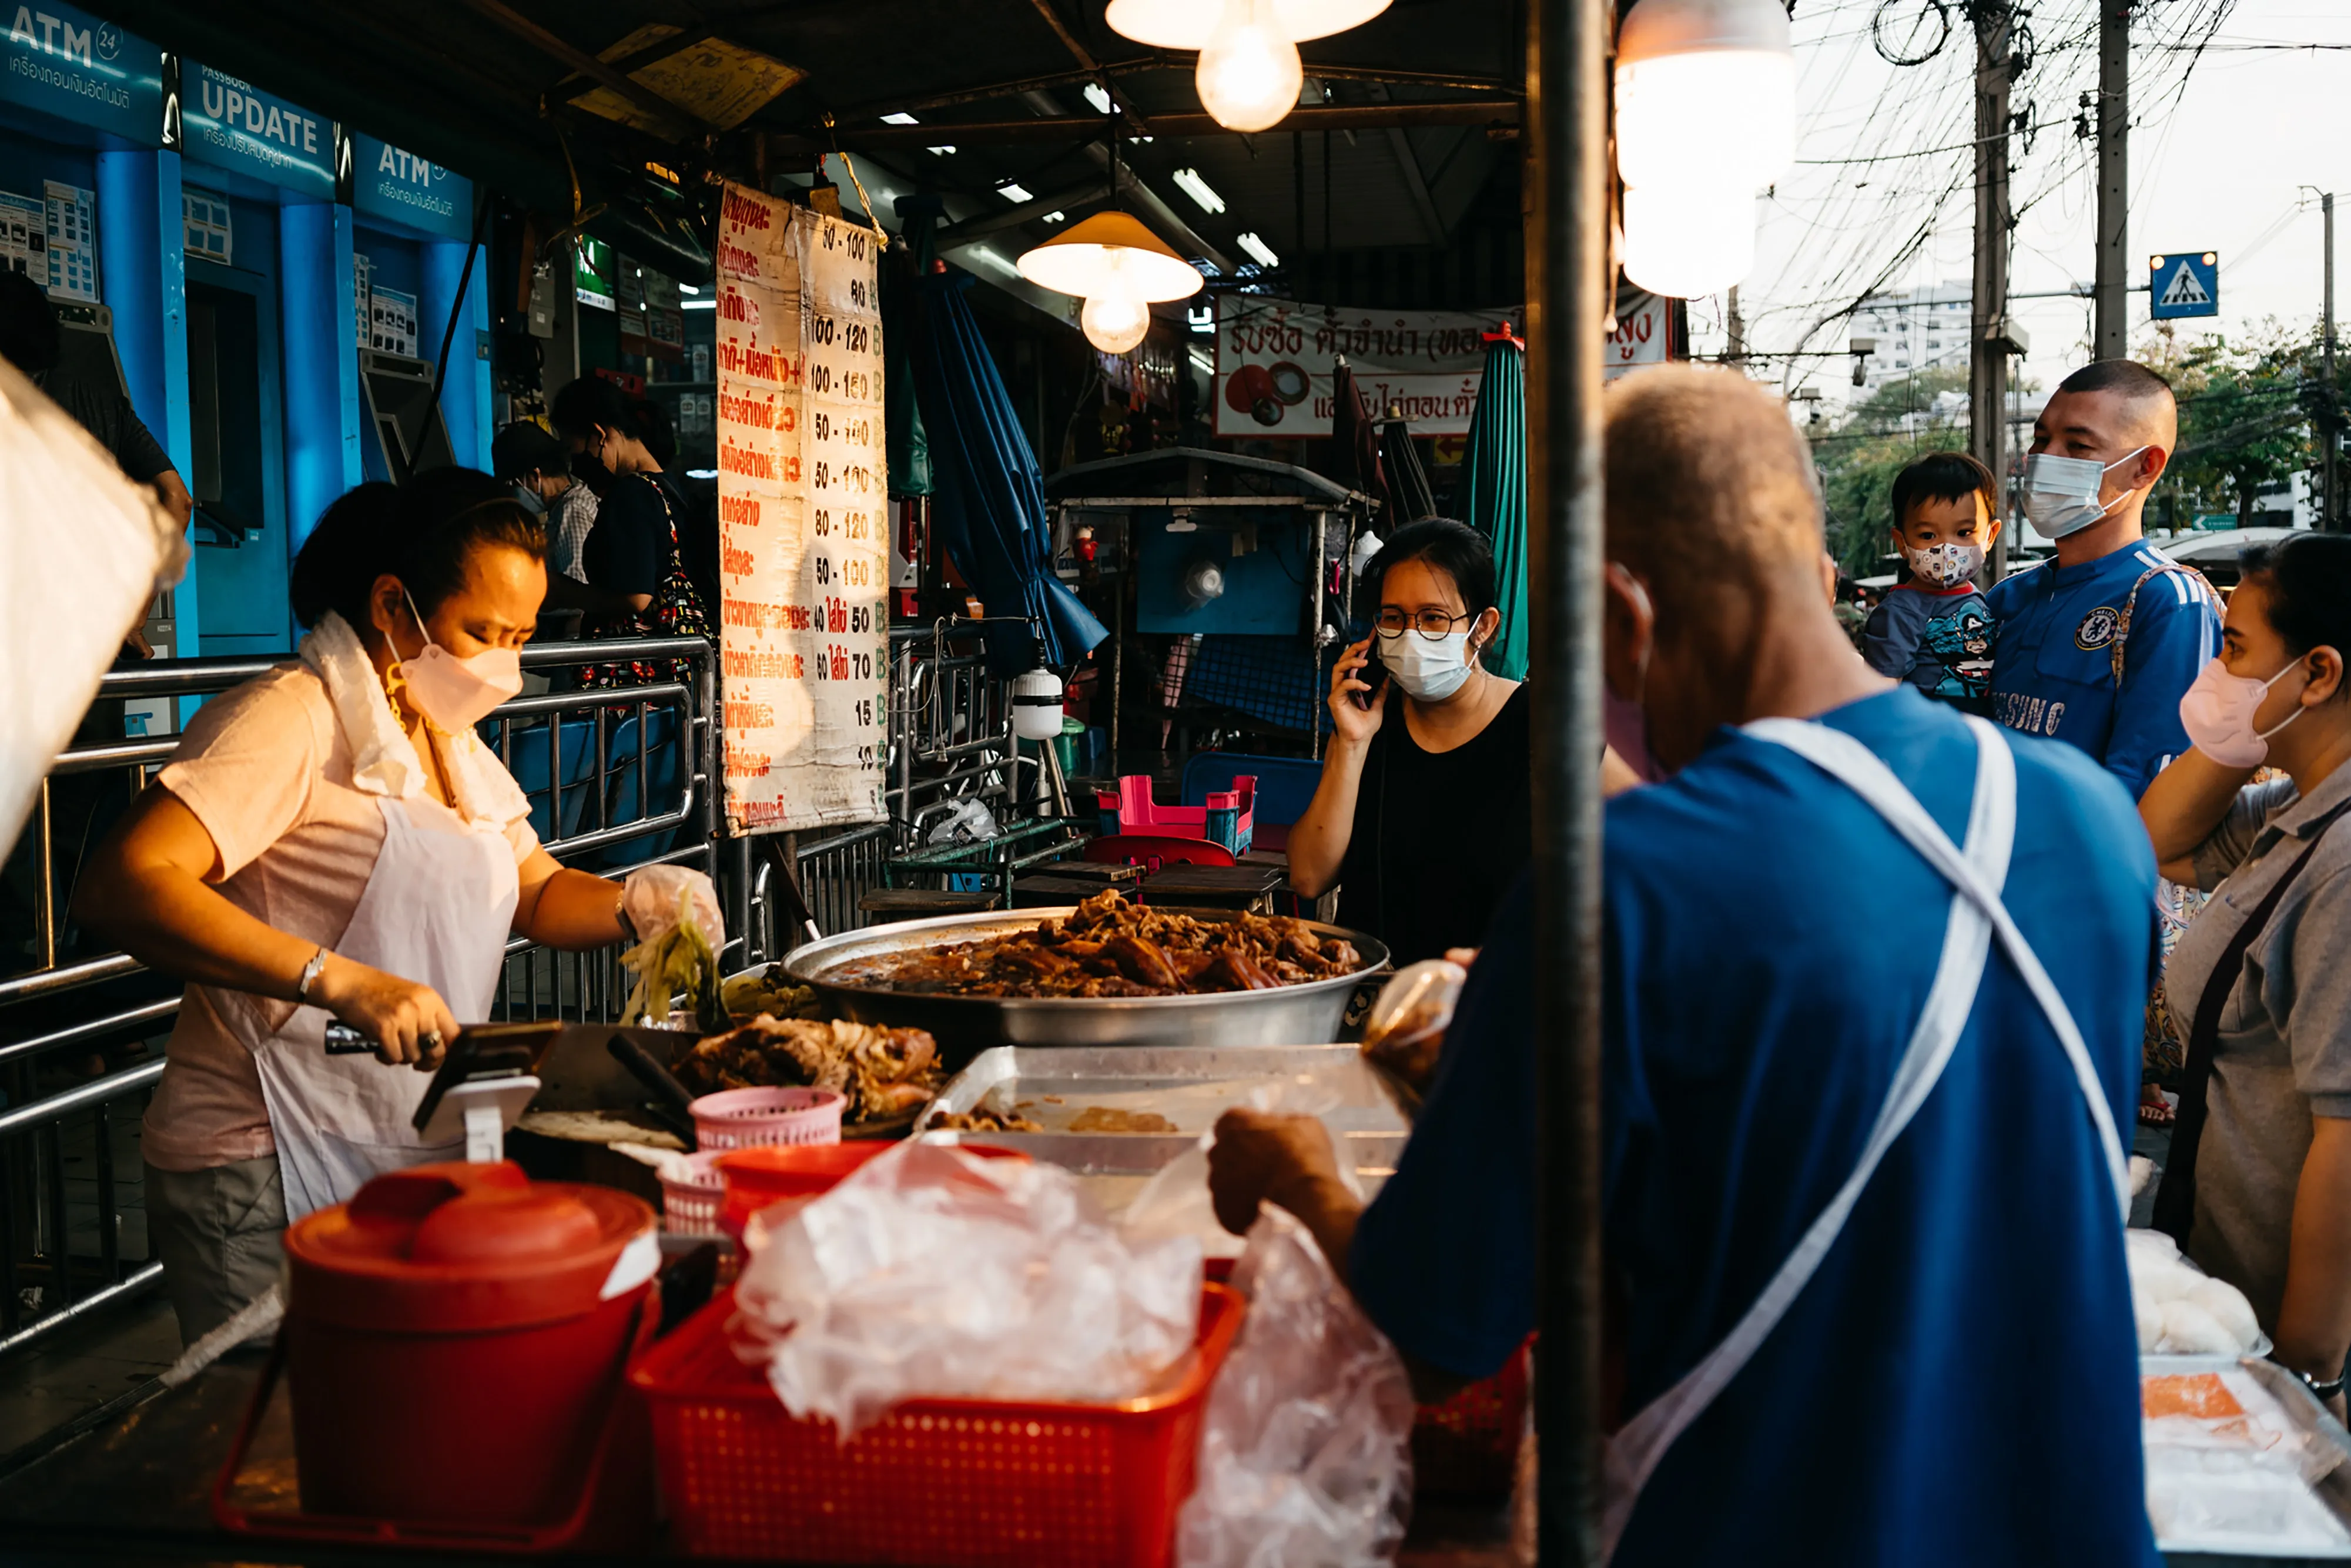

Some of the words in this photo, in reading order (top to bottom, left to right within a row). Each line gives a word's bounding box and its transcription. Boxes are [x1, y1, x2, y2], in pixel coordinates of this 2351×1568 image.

[9, 5, 92, 68] ATM
[99, 31, 116, 49] 24
[202, 80, 317, 154] UPDATE
[379, 143, 429, 187] ATM
[847, 230, 865, 261] 100
[851, 279, 865, 307] 80
[812, 316, 834, 346] 100
[846, 323, 867, 354] 120
[1231, 307, 1302, 355] รับซื้อ
[811, 363, 830, 394] 100
[816, 413, 829, 441] 50
[815, 461, 828, 490] 50
[816, 509, 829, 537] 80
[845, 511, 868, 540] 120
[816, 557, 829, 585] 50
[843, 559, 869, 587] 100
[814, 605, 824, 632] 40
[852, 607, 869, 633] 50
[852, 653, 870, 680] 70
[856, 700, 871, 726] 15
[858, 746, 874, 770] 10
